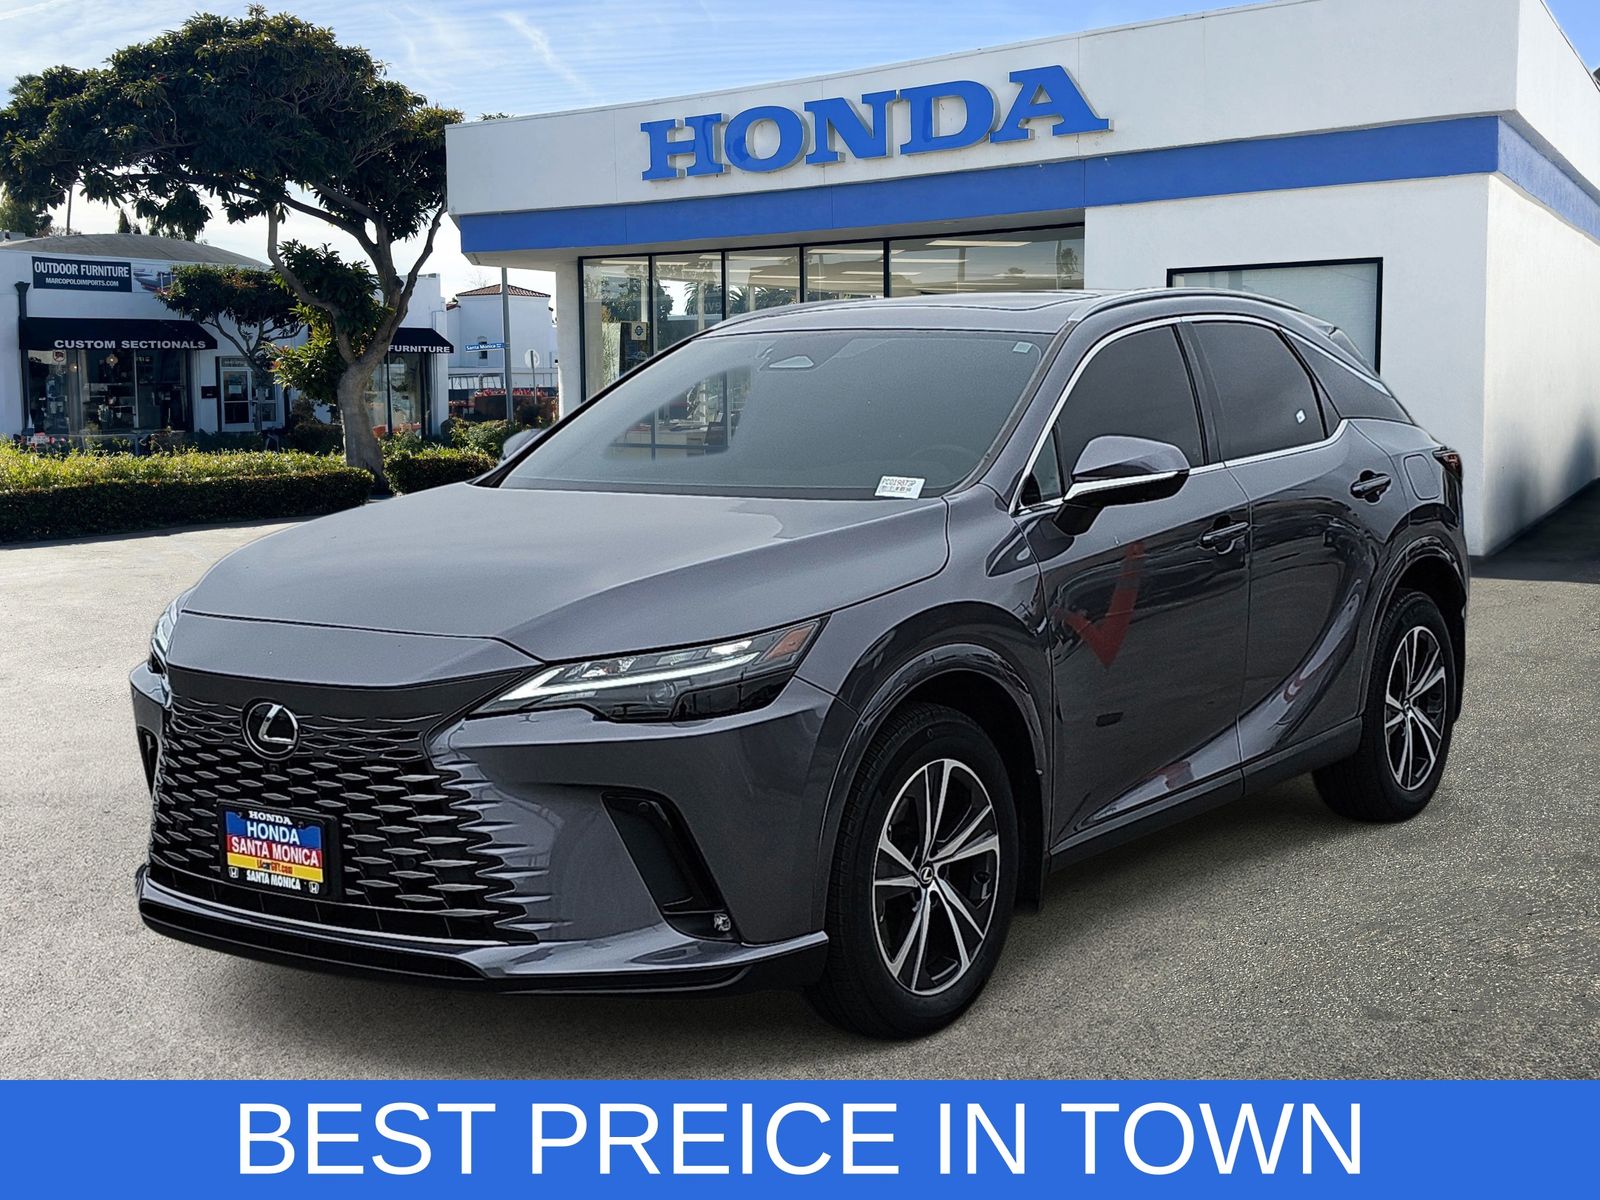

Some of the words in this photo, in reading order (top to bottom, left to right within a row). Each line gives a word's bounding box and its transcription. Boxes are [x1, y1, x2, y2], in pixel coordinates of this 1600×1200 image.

[640, 65, 1111, 181] HONDA
[34, 261, 79, 275] OUTDOOR
[80, 264, 130, 278] FURNITURE
[45, 277, 119, 287] MARCOPOLOIMPORTS.COM
[54, 339, 116, 349] CUSTOM
[121, 340, 206, 349] SECTIONALS
[388, 345, 450, 353] FURNITURE
[248, 810, 292, 825] HONDA
[246, 821, 299, 845] HONDA
[231, 836, 270, 858] SANTA
[272, 843, 319, 867] MONICA
[246, 869, 269, 884] SANTA
[270, 875, 301, 890] MONICA
